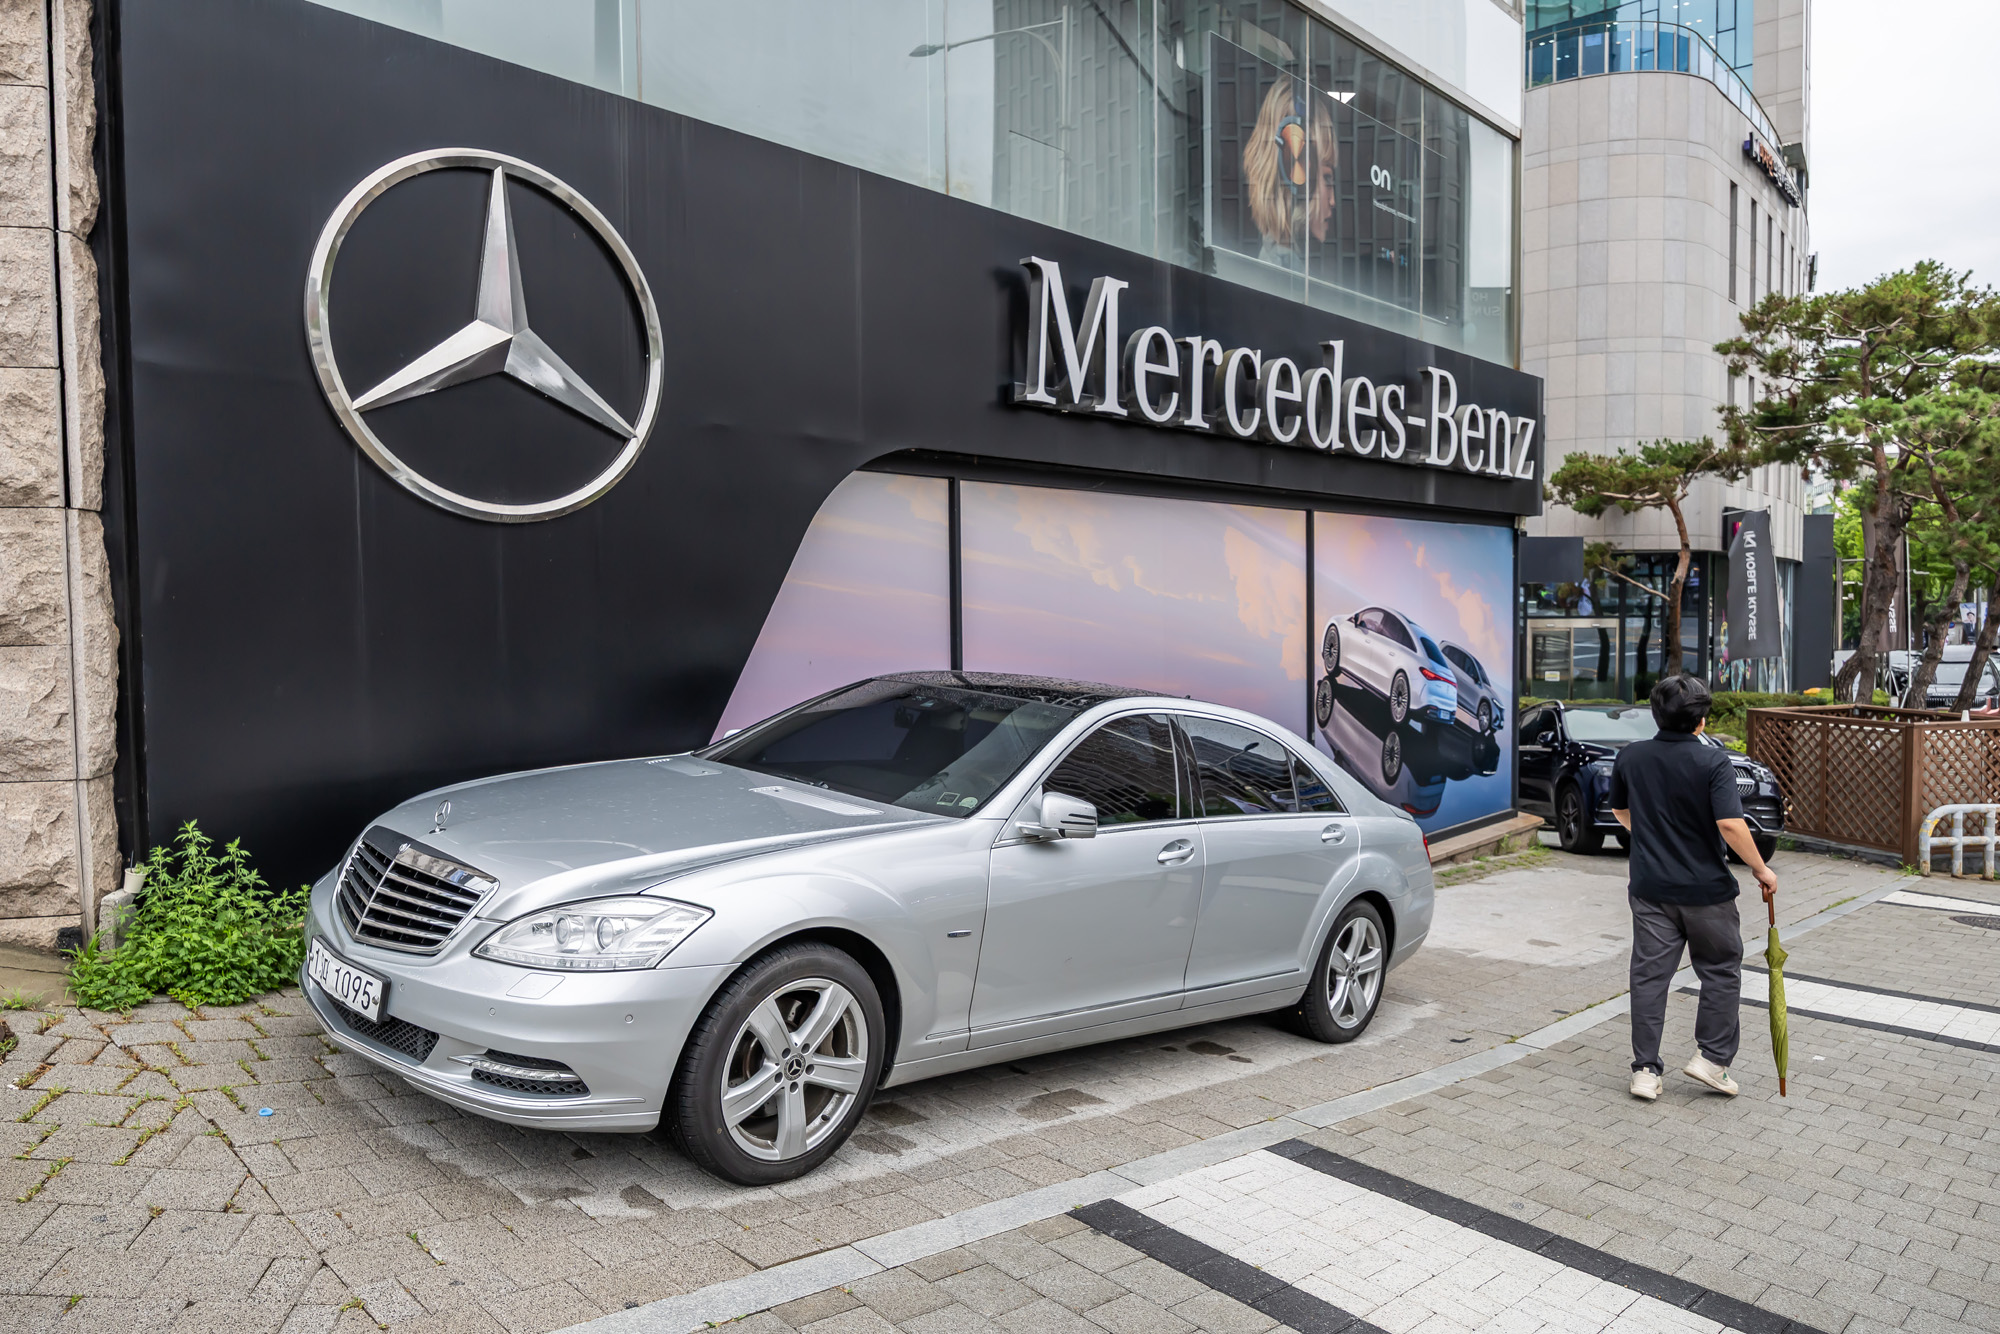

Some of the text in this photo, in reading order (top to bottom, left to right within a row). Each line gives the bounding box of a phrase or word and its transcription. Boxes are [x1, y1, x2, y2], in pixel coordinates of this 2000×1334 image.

[1370, 164, 1391, 191] on
[1018, 255, 1535, 481] Mercedes-Benz
[335, 967, 373, 1010] 1095
